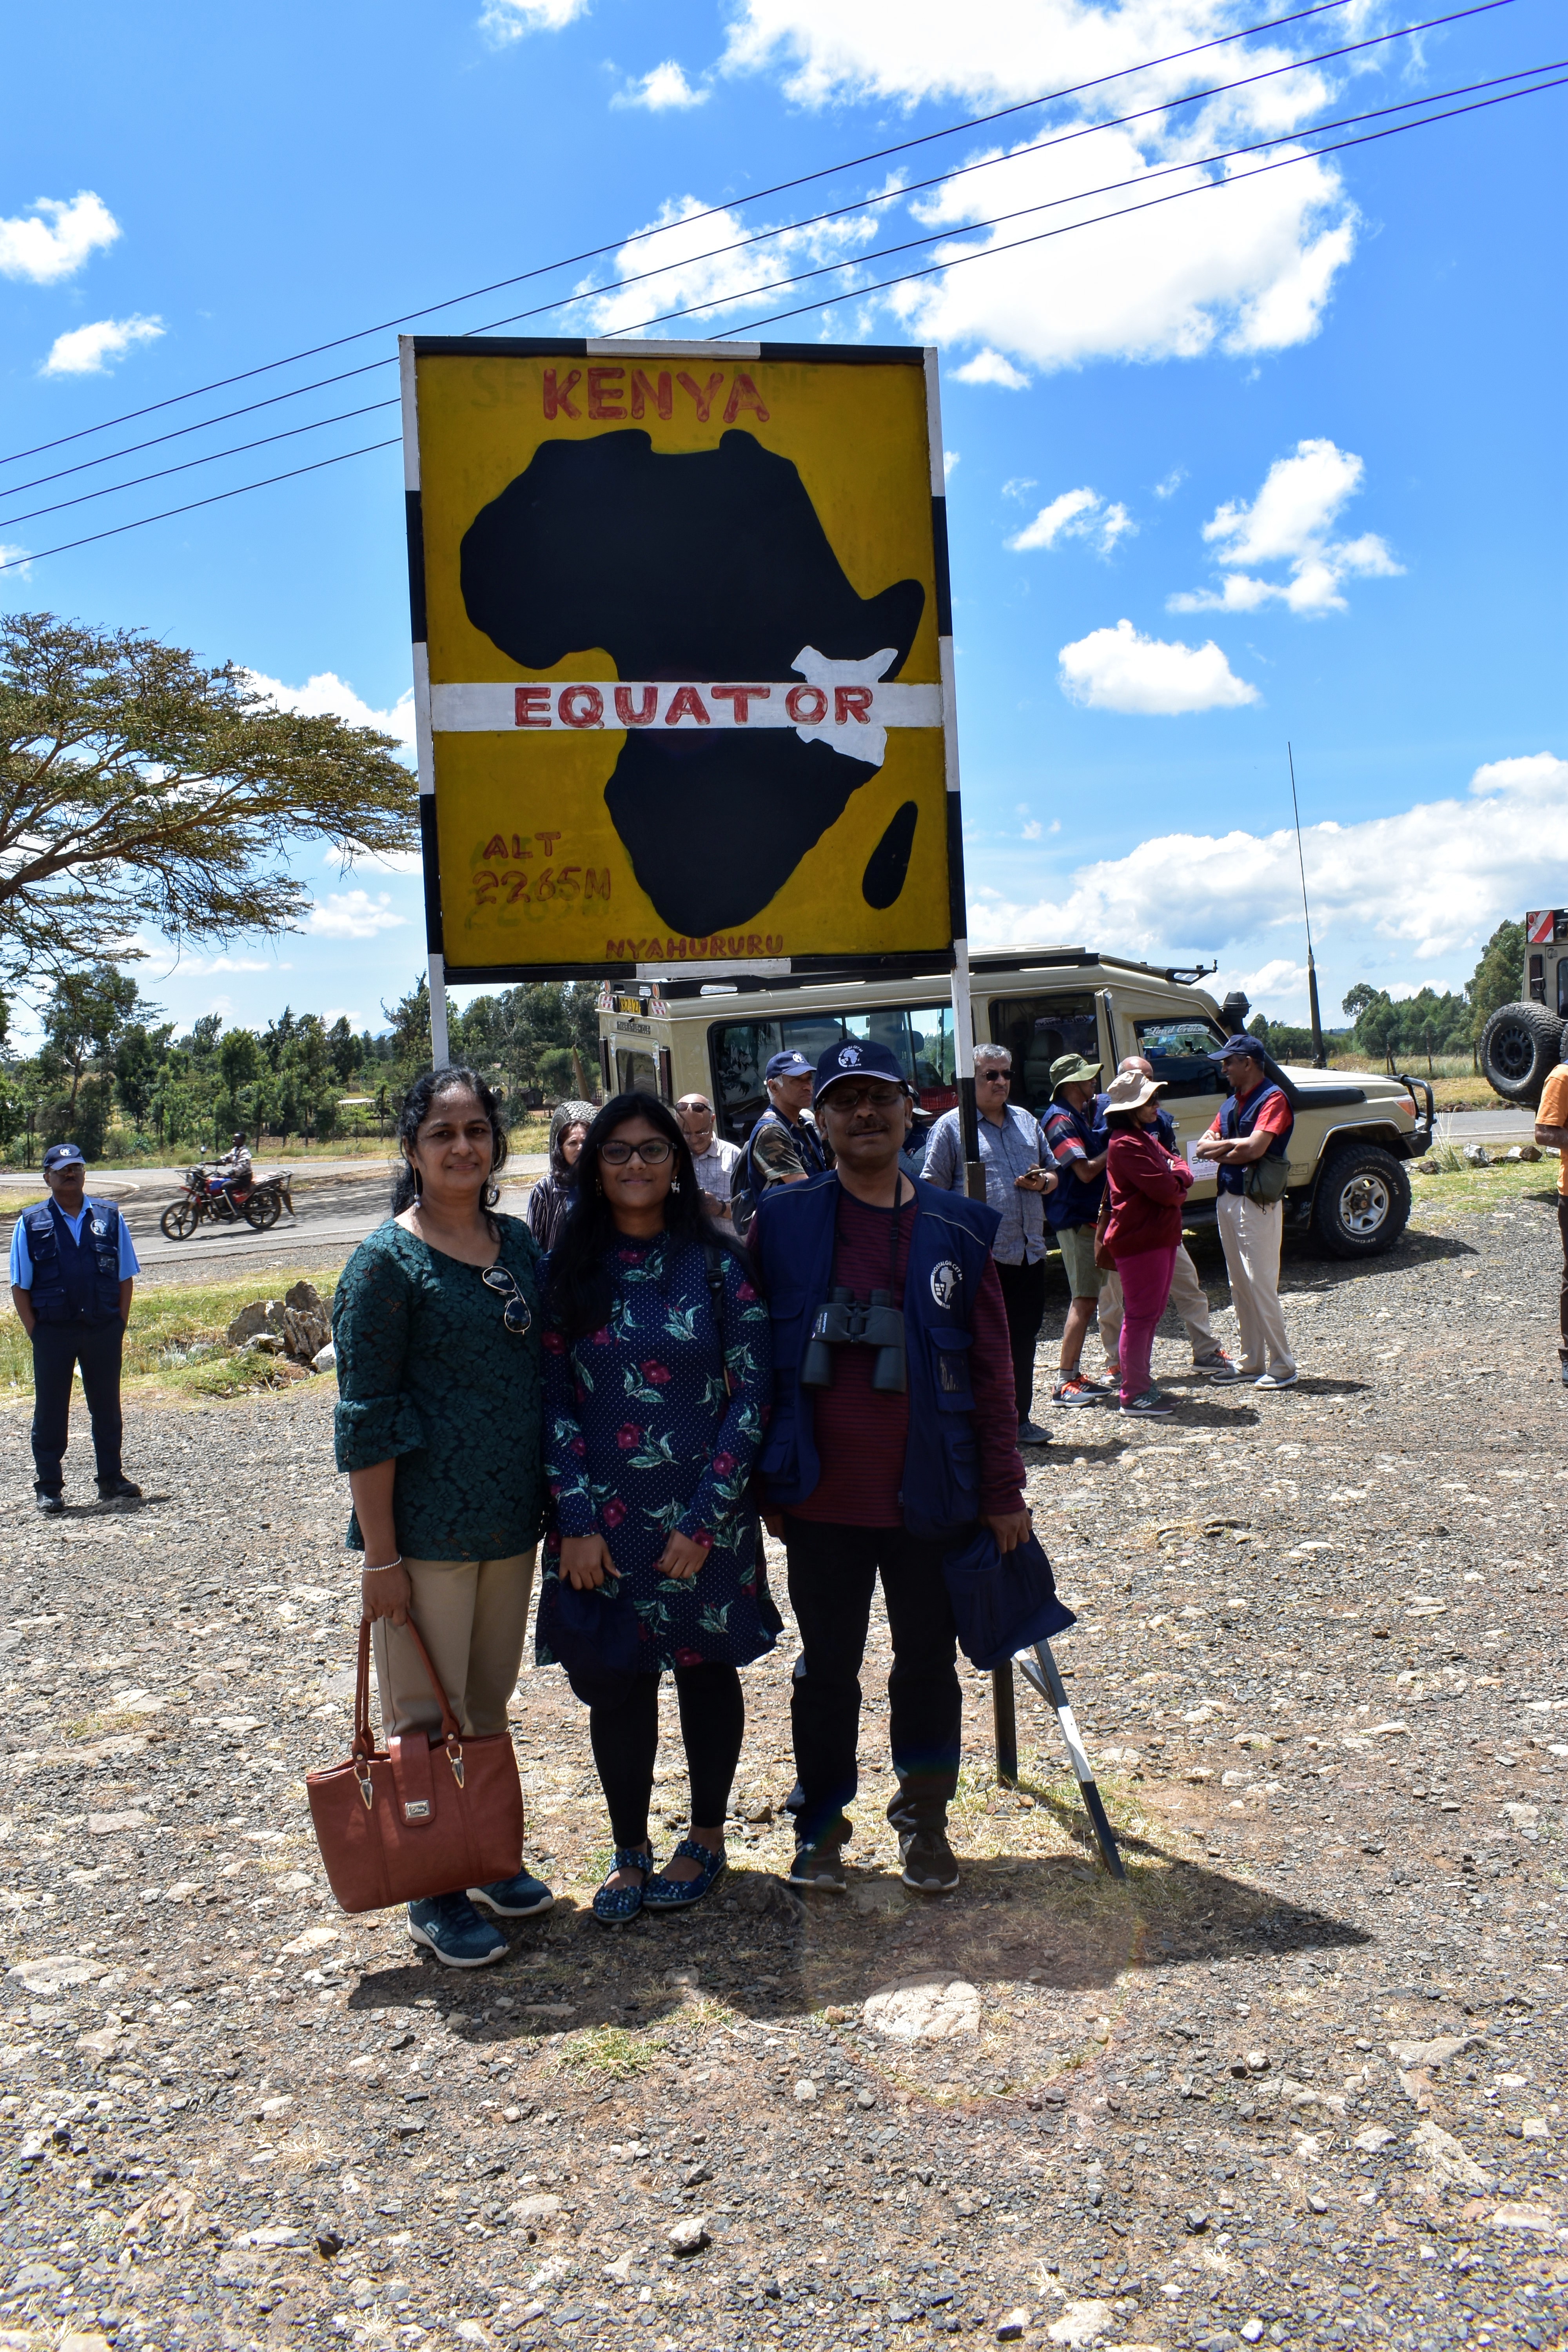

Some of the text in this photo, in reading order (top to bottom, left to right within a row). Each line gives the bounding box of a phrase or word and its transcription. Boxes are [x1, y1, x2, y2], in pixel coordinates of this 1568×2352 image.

[543, 367, 770, 423] KENYA
[514, 684, 873, 729] EQUATOR
[483, 831, 561, 860] ALT
[472, 867, 611, 906] 2265M
[606, 934, 783, 960] NYAHURURU
[1147, 1026, 1175, 1036] Land
[952, 1264, 961, 1273] CET
